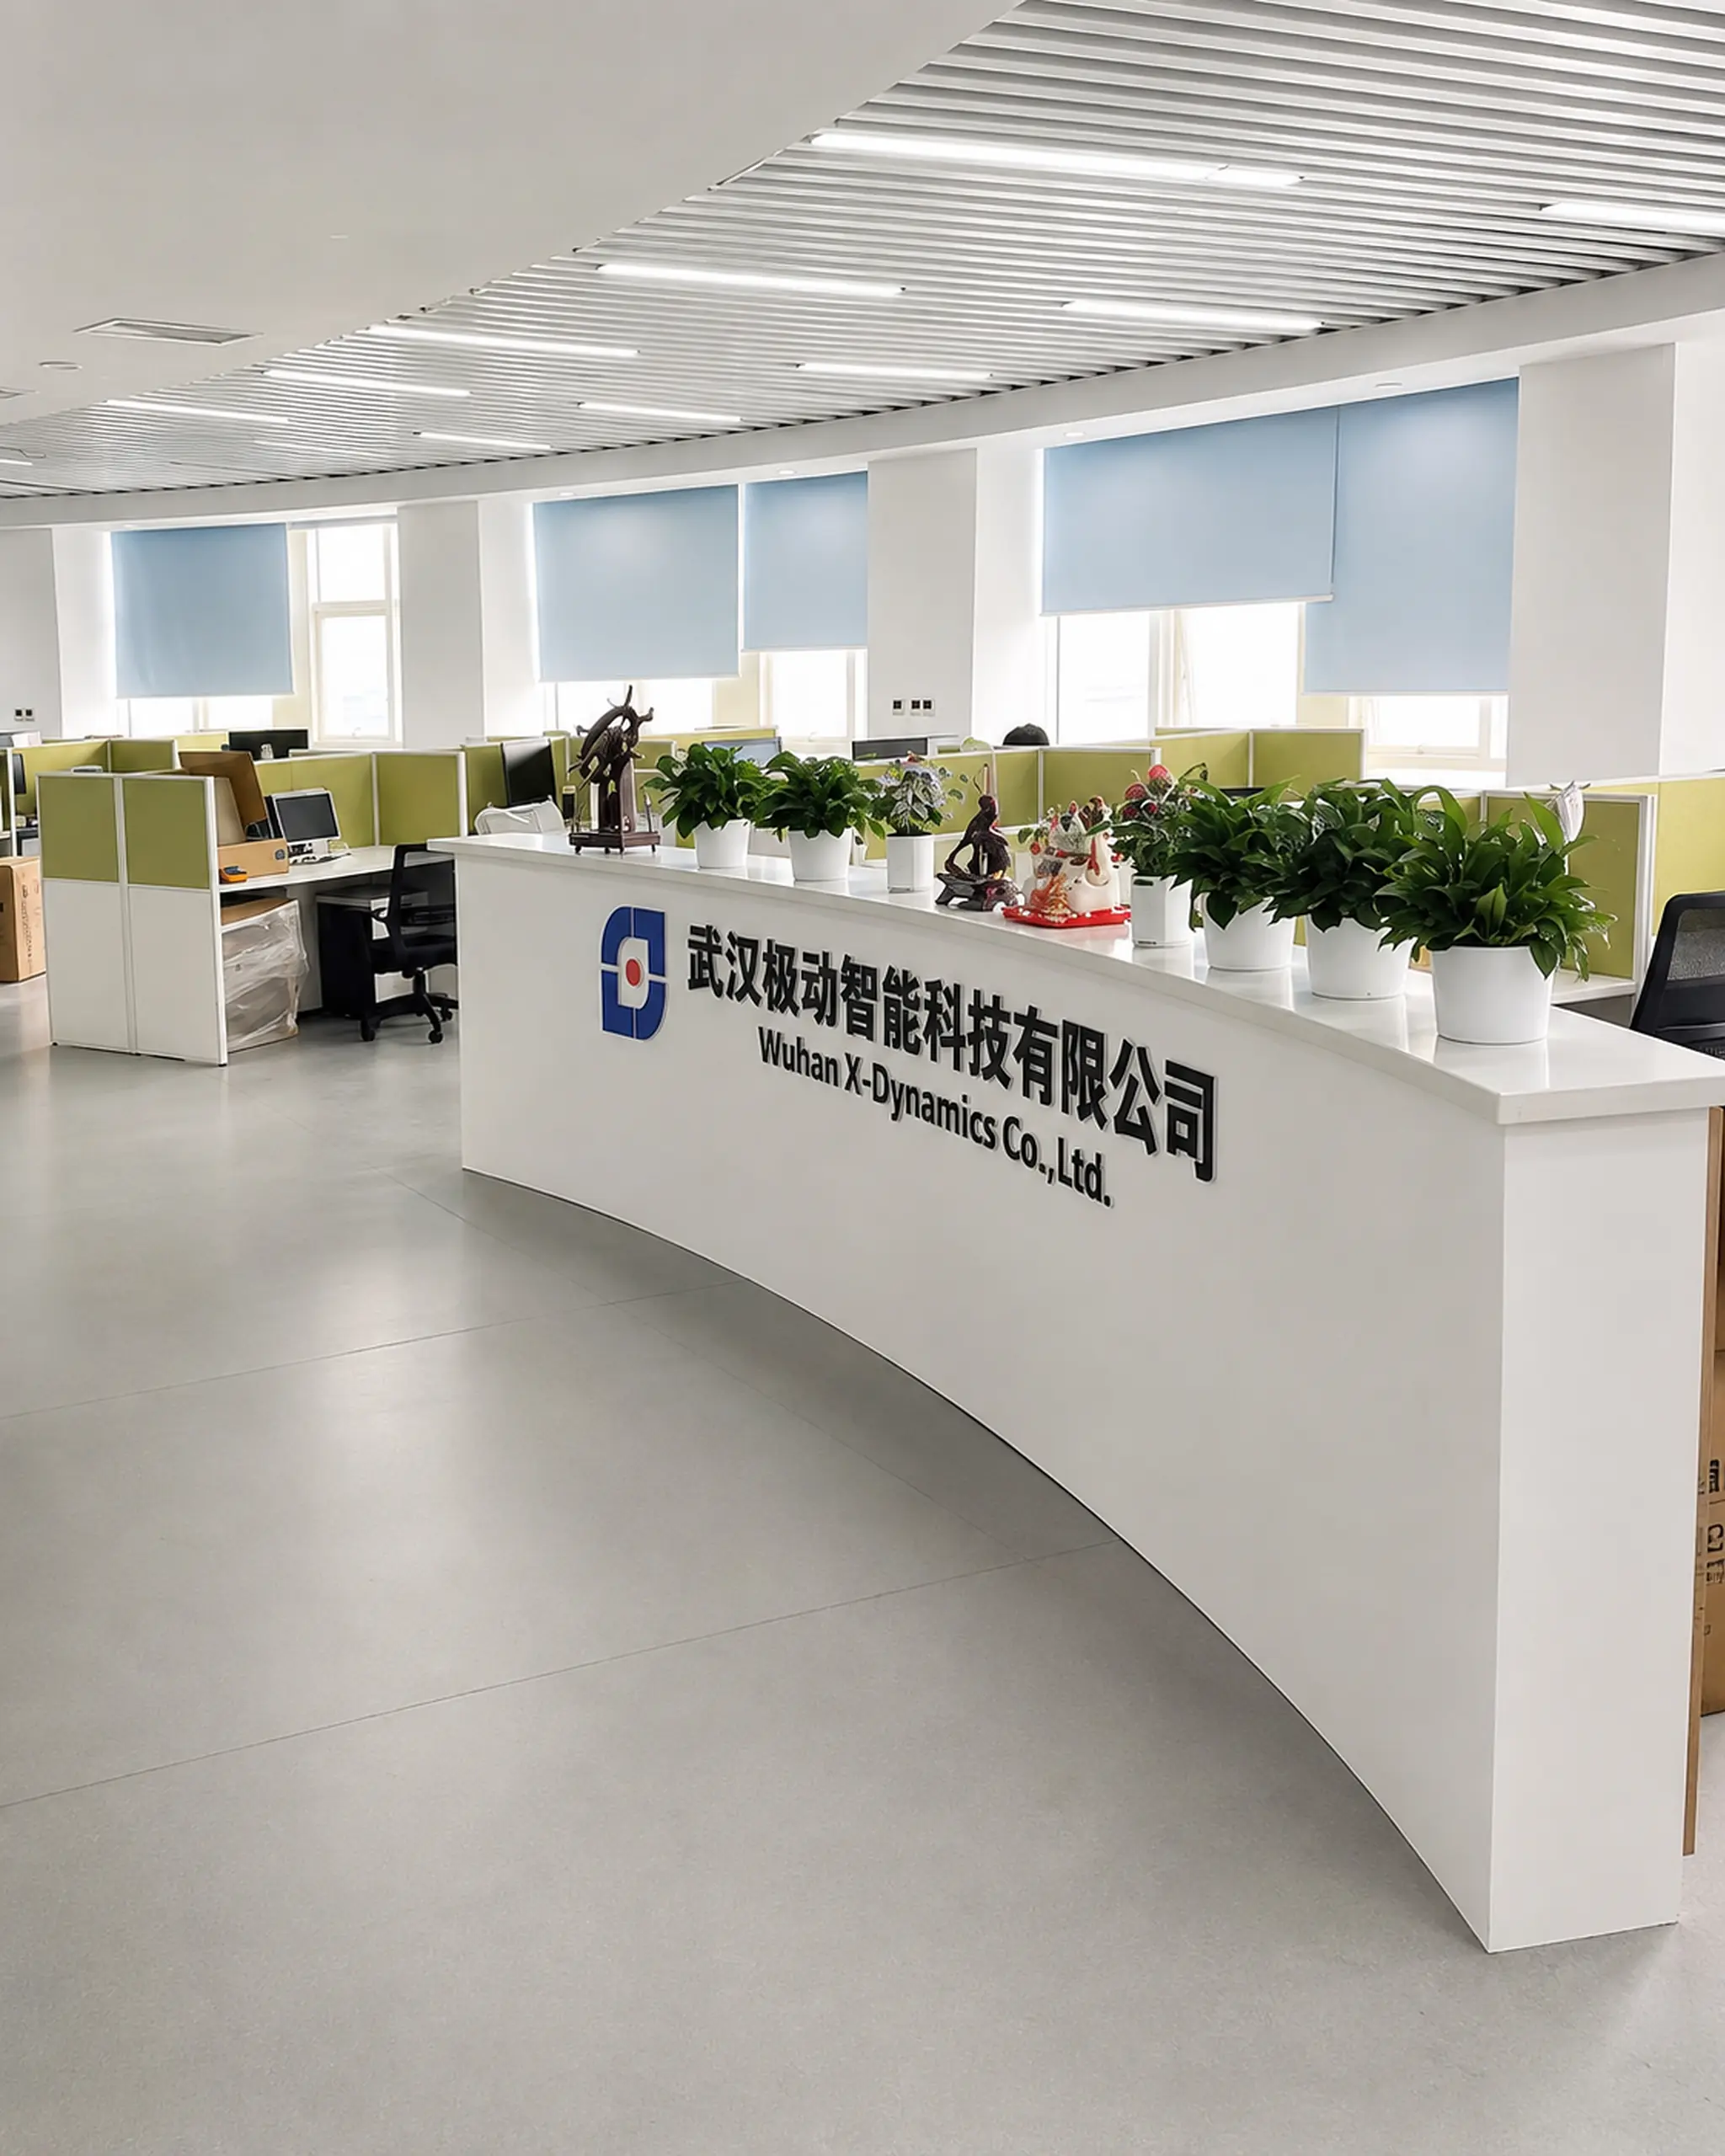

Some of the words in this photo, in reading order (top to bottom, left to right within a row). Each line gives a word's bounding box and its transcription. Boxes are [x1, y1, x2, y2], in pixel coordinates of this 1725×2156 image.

[687, 924, 1215, 1182] 武汉极动智能科技有限公司
[758, 1026, 840, 1087] Wuhan
[844, 1052, 996, 1150] X-Dynamics
[1002, 1116, 1112, 1208] Co.,Ltd.
